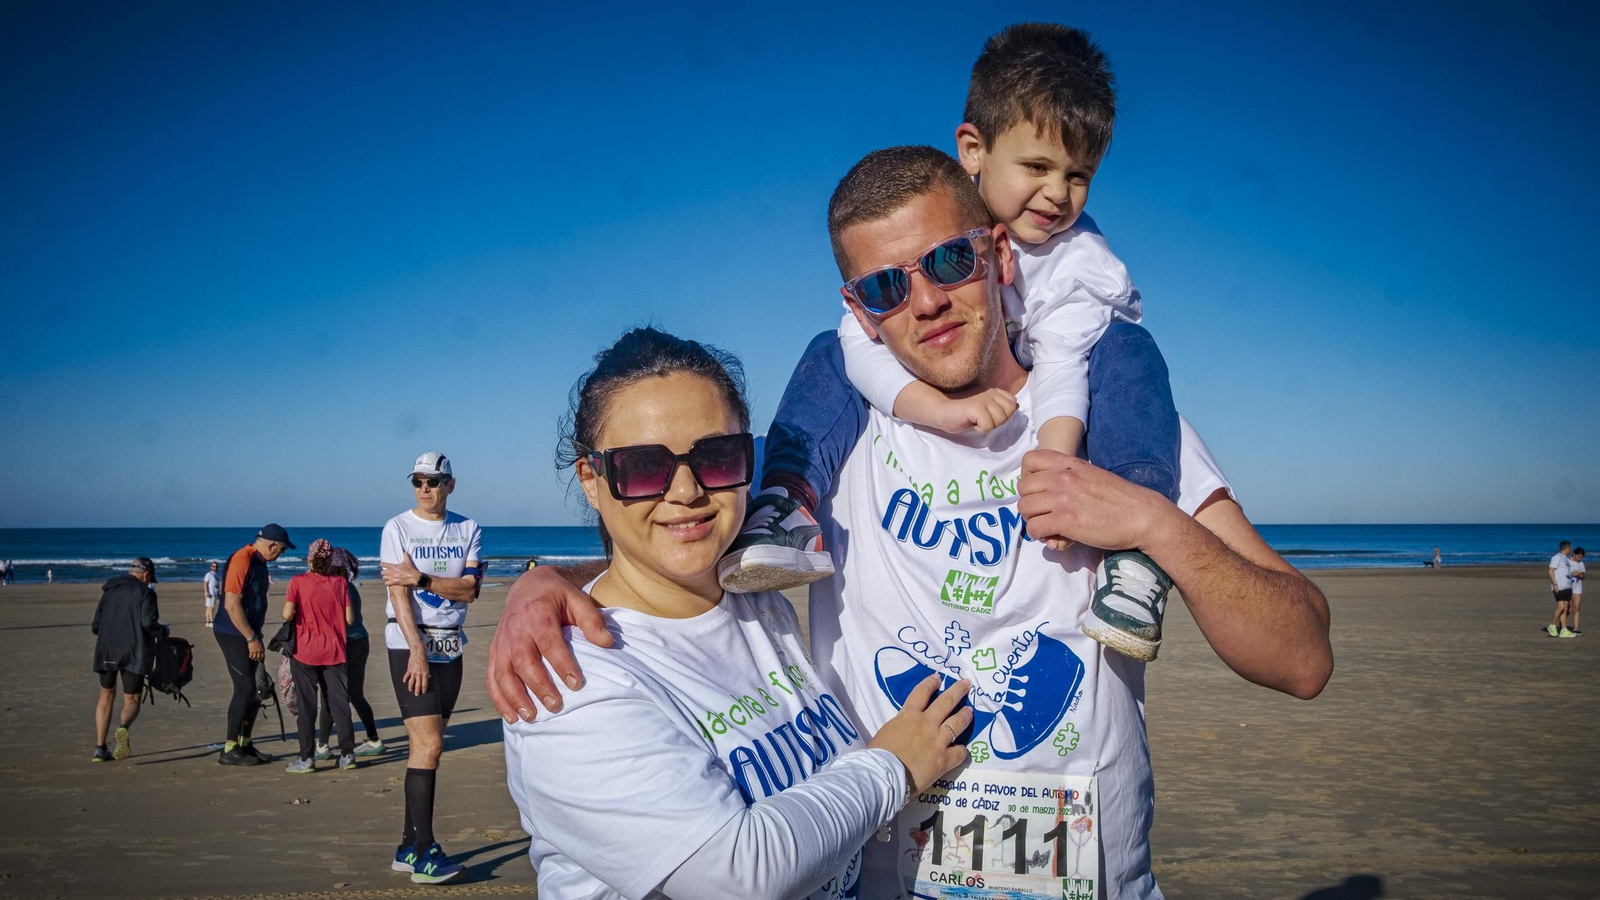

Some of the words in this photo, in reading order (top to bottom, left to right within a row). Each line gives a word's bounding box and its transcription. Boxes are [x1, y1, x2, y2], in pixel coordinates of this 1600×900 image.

[946, 479, 959, 505] a
[975, 470, 1021, 501] fav
[881, 488, 1034, 567] AUTISM
[415, 545, 464, 559] AUTISMO
[941, 600, 970, 612] AUTISMO
[428, 639, 459, 652] 1003
[897, 625, 965, 681] Cada
[971, 782, 980, 793] A
[984, 784, 1017, 797] FAVOR
[1021, 787, 1039, 798] DEL
[955, 797, 968, 808] de
[1007, 804, 1017, 813] 30
[1019, 805, 1030, 813] de
[1058, 807, 1073, 816] 2025
[921, 811, 1067, 877] 1111
[424, 862, 437, 875] N
[929, 871, 985, 888] CARLOS
